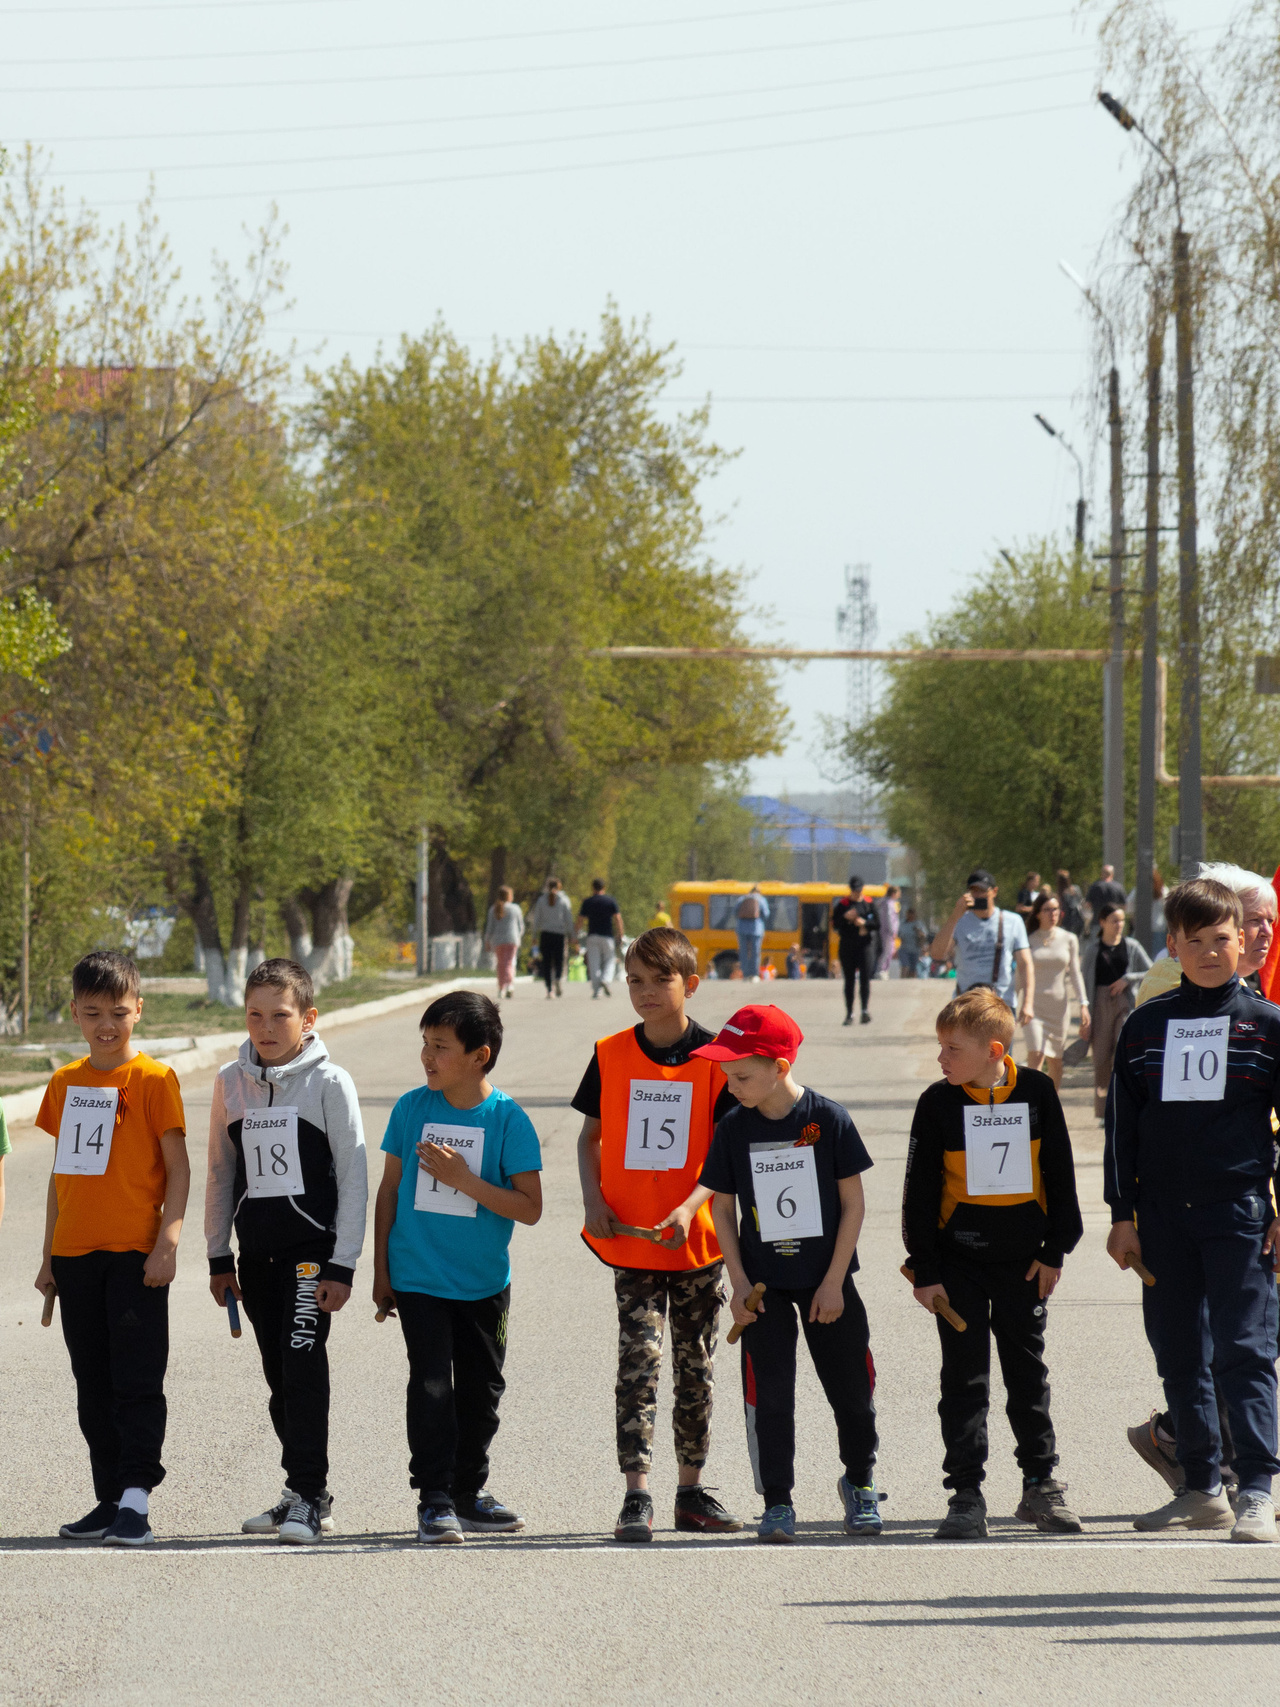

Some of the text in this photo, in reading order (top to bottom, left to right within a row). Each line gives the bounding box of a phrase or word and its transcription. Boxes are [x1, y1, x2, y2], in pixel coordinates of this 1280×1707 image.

[1174, 1028, 1224, 1039] Знамя
[1180, 1049, 1219, 1081] 10
[70, 1096, 113, 1108] Знамя
[633, 1089, 682, 1103] Знамя
[243, 1118, 288, 1130] Знамя
[972, 1115, 1023, 1127] Знамя
[71, 1122, 104, 1155] 14
[638, 1117, 676, 1150] 15
[253, 1143, 288, 1177] 18
[754, 1160, 805, 1173] Знамя
[990, 1142, 1010, 1174] 7
[776, 1185, 797, 1219] 6
